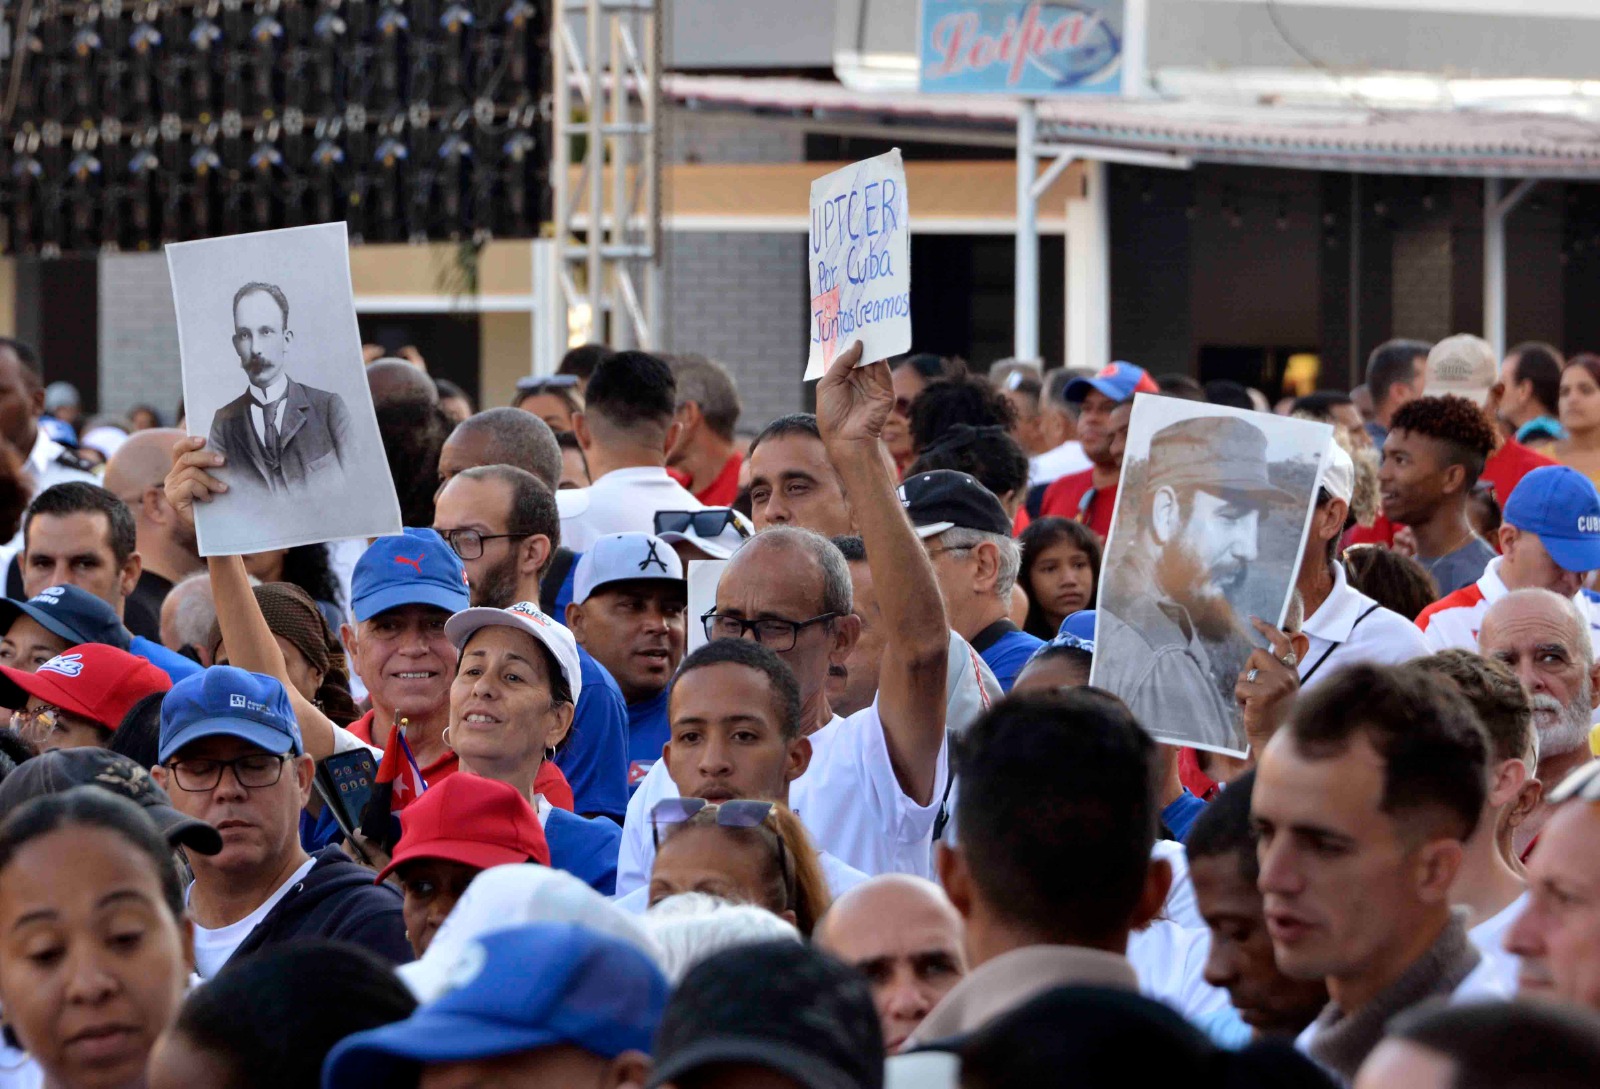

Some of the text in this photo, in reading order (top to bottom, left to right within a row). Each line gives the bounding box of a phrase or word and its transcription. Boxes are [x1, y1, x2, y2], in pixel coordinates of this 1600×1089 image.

[812, 179, 898, 254] UPTCER
[818, 240, 894, 293] Por Cuba
[1577, 515, 1600, 533] CUB
